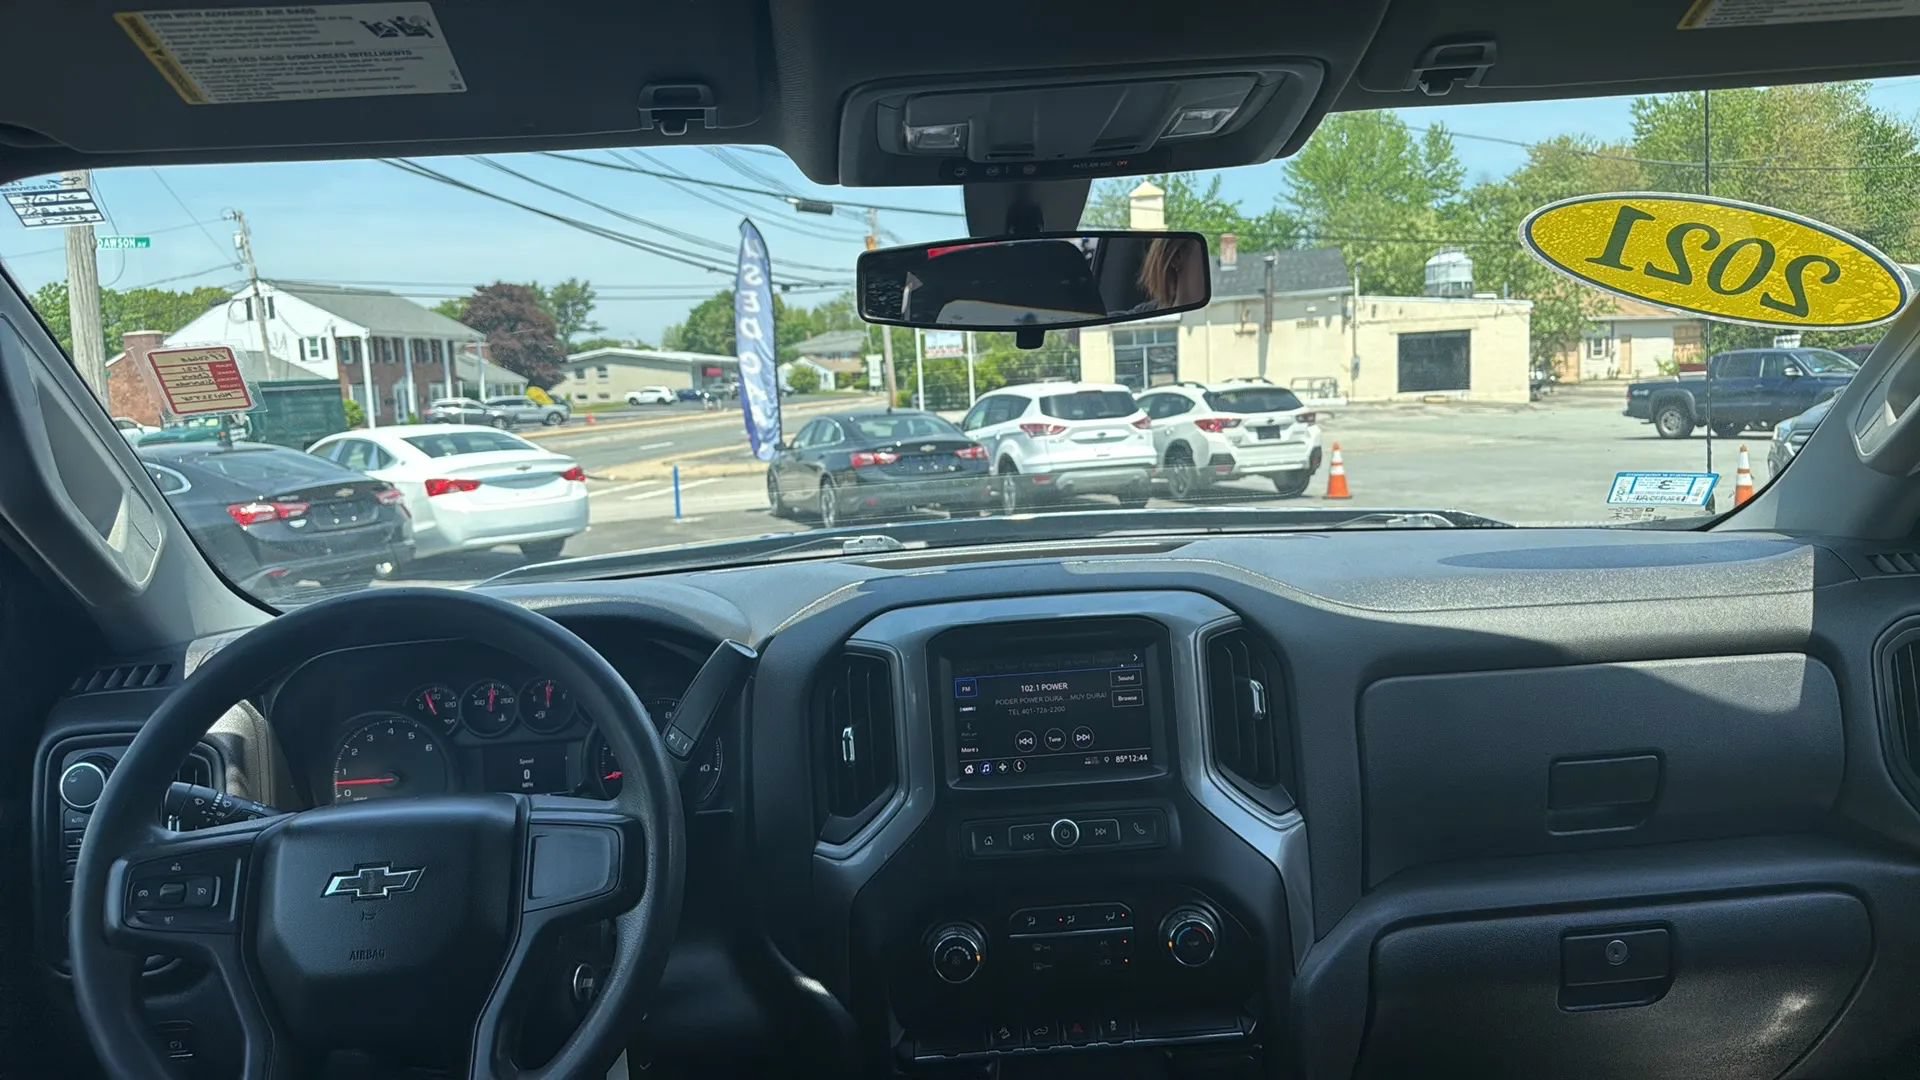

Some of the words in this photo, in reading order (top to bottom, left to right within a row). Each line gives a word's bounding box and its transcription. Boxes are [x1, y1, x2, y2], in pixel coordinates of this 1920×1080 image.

[97, 238, 136, 249] DAWSON
[1021, 684, 1040, 693] 102.1
[1041, 682, 1068, 691] POWER
[995, 697, 1019, 706] PODER
[1008, 708, 1020, 716] TEL
[387, 727, 395, 735] 4
[366, 734, 374, 742] 3
[407, 732, 415, 740] 5
[425, 743, 433, 752] 6
[351, 748, 358, 756] 2
[519, 758, 534, 766] Speed
[1128, 754, 1148, 762] 12:44
[523, 769, 530, 780] 0
[344, 789, 352, 797] 0
